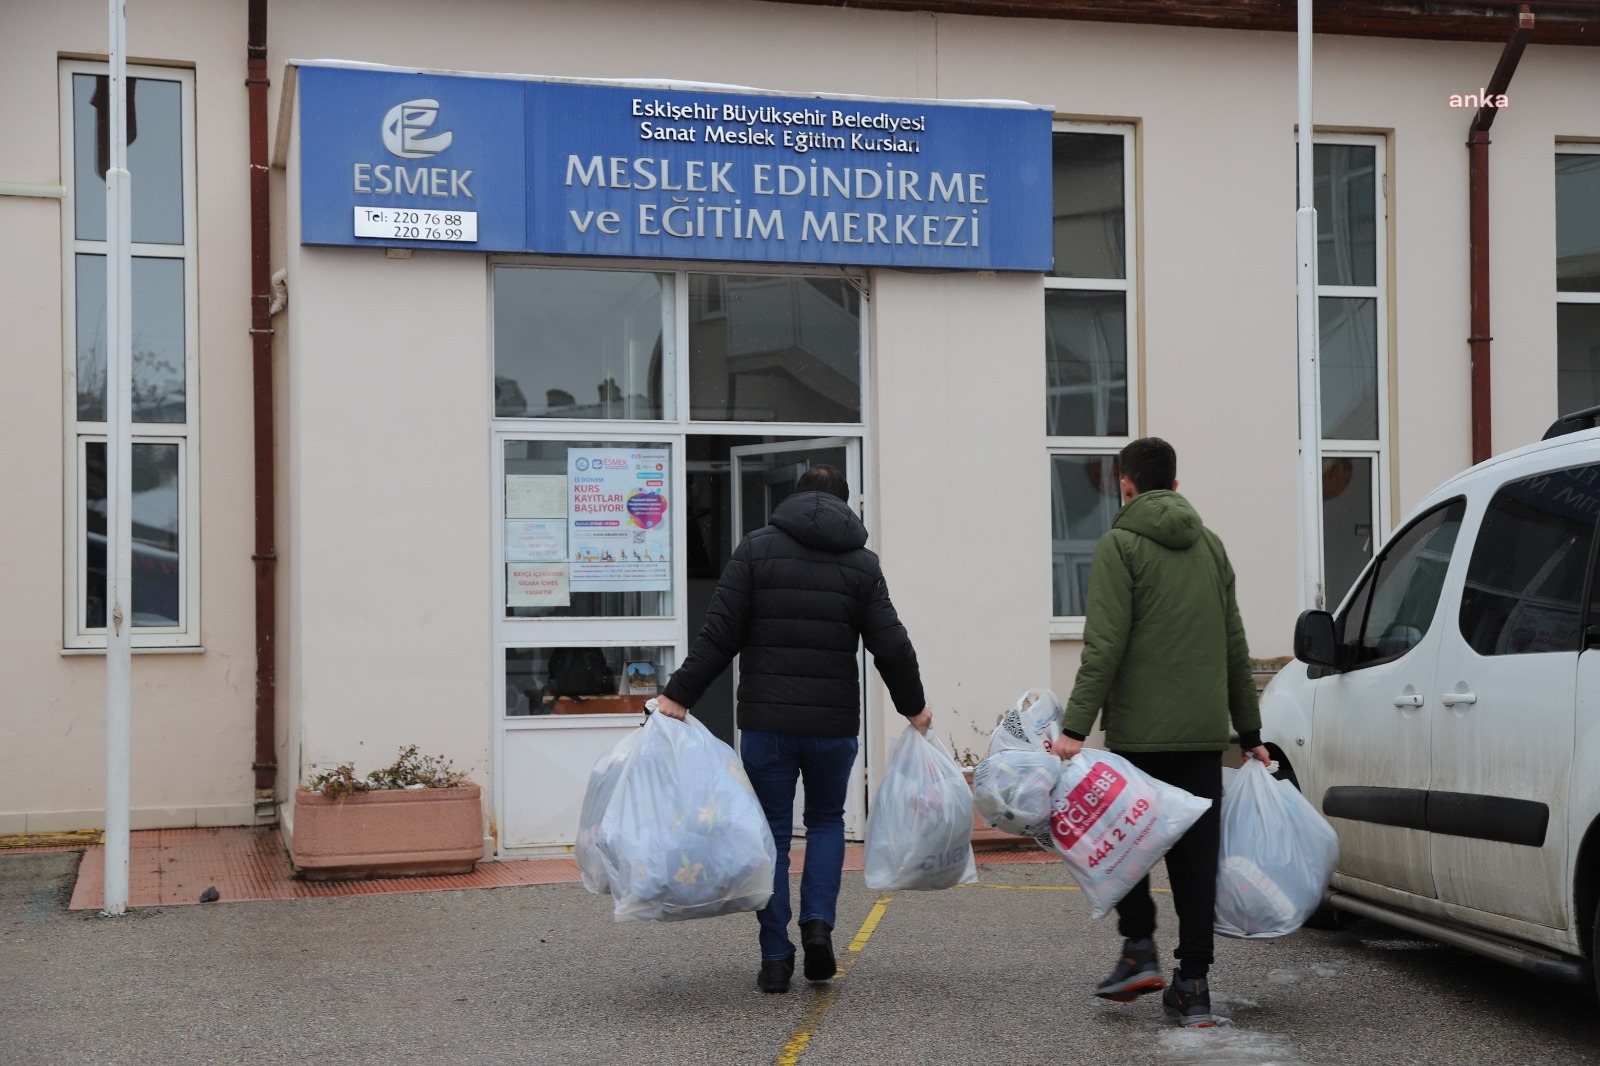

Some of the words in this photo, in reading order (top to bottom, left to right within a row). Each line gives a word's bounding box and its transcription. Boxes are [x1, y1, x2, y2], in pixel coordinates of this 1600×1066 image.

[632, 98, 718, 120] Eskişehir
[723, 104, 827, 127] Büyükşehir
[832, 110, 926, 133] Belediyesi
[640, 121, 696, 142] Sanat
[704, 125, 776, 146] Meslek
[783, 130, 845, 153] Eğitim
[851, 132, 920, 153] Kursları
[353, 162, 475, 198] ESMEK
[565, 153, 736, 194] MESLEK
[753, 158, 989, 205] EDİNDİRME
[365, 210, 388, 222] Tel:
[394, 212, 418, 224] 220
[424, 214, 440, 224] 76
[444, 214, 462, 226] 88
[394, 226, 420, 238] 220
[424, 228, 440, 239] 76
[446, 228, 462, 240] 99
[569, 207, 621, 235] ve
[638, 195, 785, 241] EĞİTİM
[801, 208, 980, 248] MERKEZİ
[574, 484, 600, 492] KURS
[574, 504, 624, 514] BAŞLIYOR!
[1056, 800, 1088, 836] CİCİ
[1083, 770, 1117, 807] BEBE
[1088, 840, 1115, 868] 444
[1112, 828, 1127, 842] 2
[1124, 798, 1150, 826] 149
